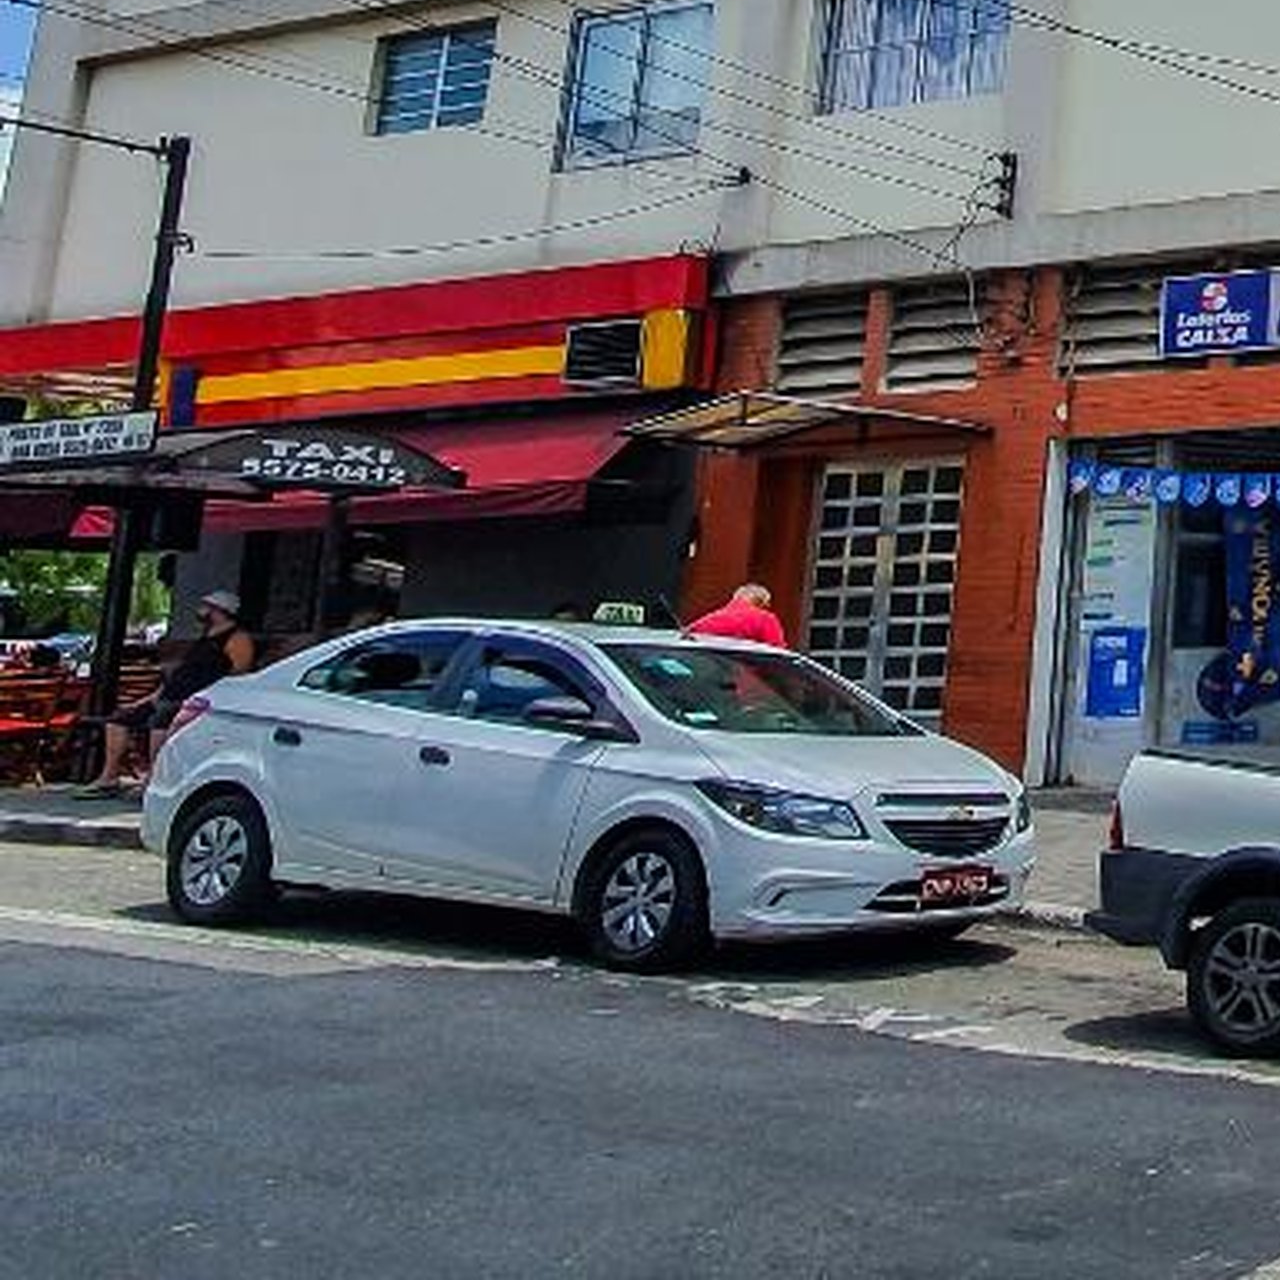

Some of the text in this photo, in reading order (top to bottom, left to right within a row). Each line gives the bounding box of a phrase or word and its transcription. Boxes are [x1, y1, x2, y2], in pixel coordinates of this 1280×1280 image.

[1176, 326, 1249, 347] CAIXA
[262, 439, 395, 464] TAXI
[242, 458, 405, 485] 5575-0412
